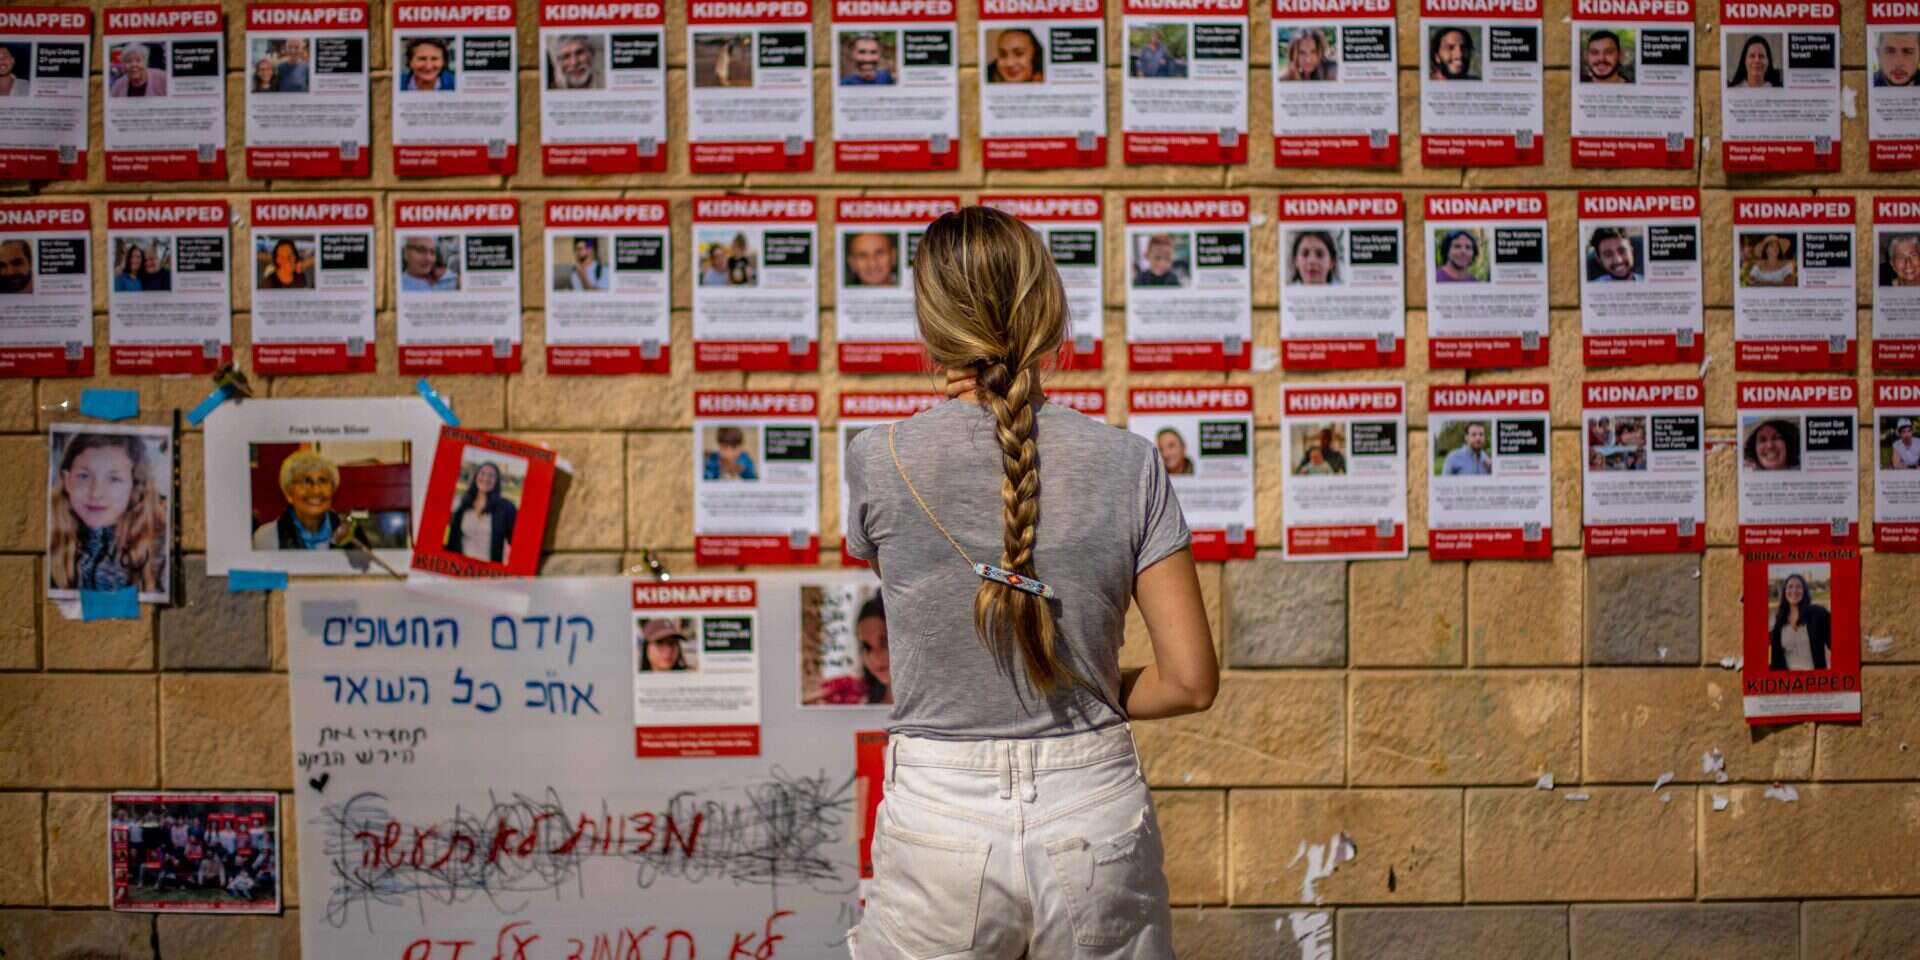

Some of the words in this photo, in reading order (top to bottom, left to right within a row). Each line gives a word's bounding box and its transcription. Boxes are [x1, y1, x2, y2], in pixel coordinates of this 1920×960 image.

[399, 5, 511, 21] KIDNAPPED
[545, 3, 659, 20] KIDNAPPED
[693, 1, 807, 18] KIDNAPPED
[837, 0, 952, 16] KIDNAPPED
[984, 0, 1099, 13] KIDNAPPED
[1277, 0, 1390, 12] KIDNAPPED
[1426, 0, 1539, 12] KIDNAPPED
[1578, 0, 1690, 15] KIDNAPPED
[1726, 4, 1834, 18] KIDNAPPED
[109, 11, 218, 28] KIDNAPPED
[252, 8, 363, 24] KIDNAPPED
[256, 204, 368, 220] KIDNAPPED
[698, 200, 813, 216] KIDNAPPED
[1130, 201, 1245, 218] KIDNAPPED
[1284, 199, 1398, 215] KIDNAPPED
[1430, 198, 1543, 214] KIDNAPPED
[1585, 196, 1695, 212] KIDNAPPED
[1740, 203, 1850, 218] KIDNAPPED
[113, 206, 223, 222] KIDNAPPED
[400, 204, 514, 221] KIDNAPPED
[550, 205, 664, 221] KIDNAPPED
[1590, 339, 1612, 347] Please
[1742, 344, 1764, 352] Please
[1133, 390, 1248, 408] KIDNAPPED
[1434, 389, 1544, 406] KIDNAPPED
[1588, 385, 1698, 402] KIDNAPPED
[1743, 386, 1852, 402] KIDNAPPED
[699, 395, 814, 412] KIDNAPPED
[1289, 394, 1397, 411] KIDNAPPED
[1436, 532, 1458, 540] Please
[1591, 528, 1613, 536] Please
[1745, 528, 1767, 536] Please
[636, 586, 752, 603] KIDNAPPED
[322, 615, 460, 649] החטופים
[489, 614, 595, 665] קודם
[322, 674, 430, 705] השאר
[451, 667, 503, 714] כל
[1747, 674, 1856, 693] KIDNAPPED
[729, 910, 798, 960] לא
